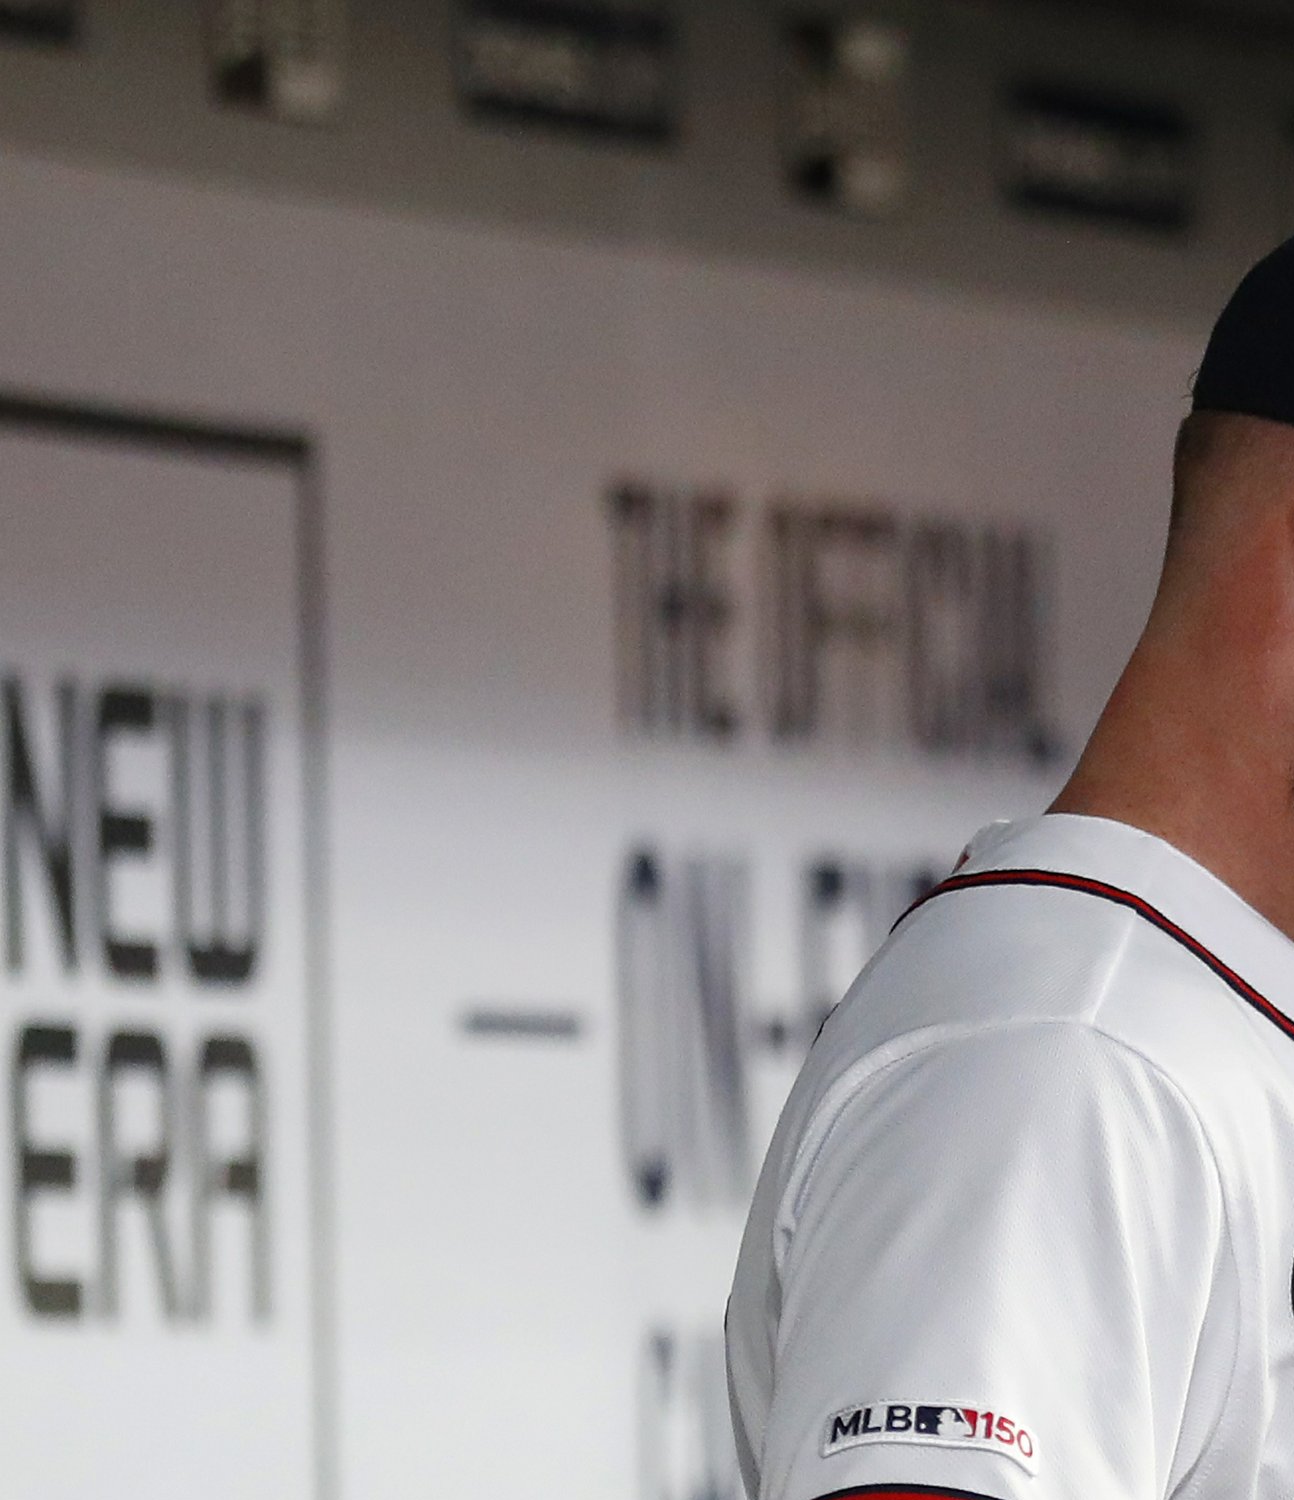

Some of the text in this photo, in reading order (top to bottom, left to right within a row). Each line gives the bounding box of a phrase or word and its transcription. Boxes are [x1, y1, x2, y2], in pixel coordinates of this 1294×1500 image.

[0, 674, 262, 986] NEW
[14, 1022, 270, 1324] ERA
[830, 1405, 1034, 1458] MLB 150
